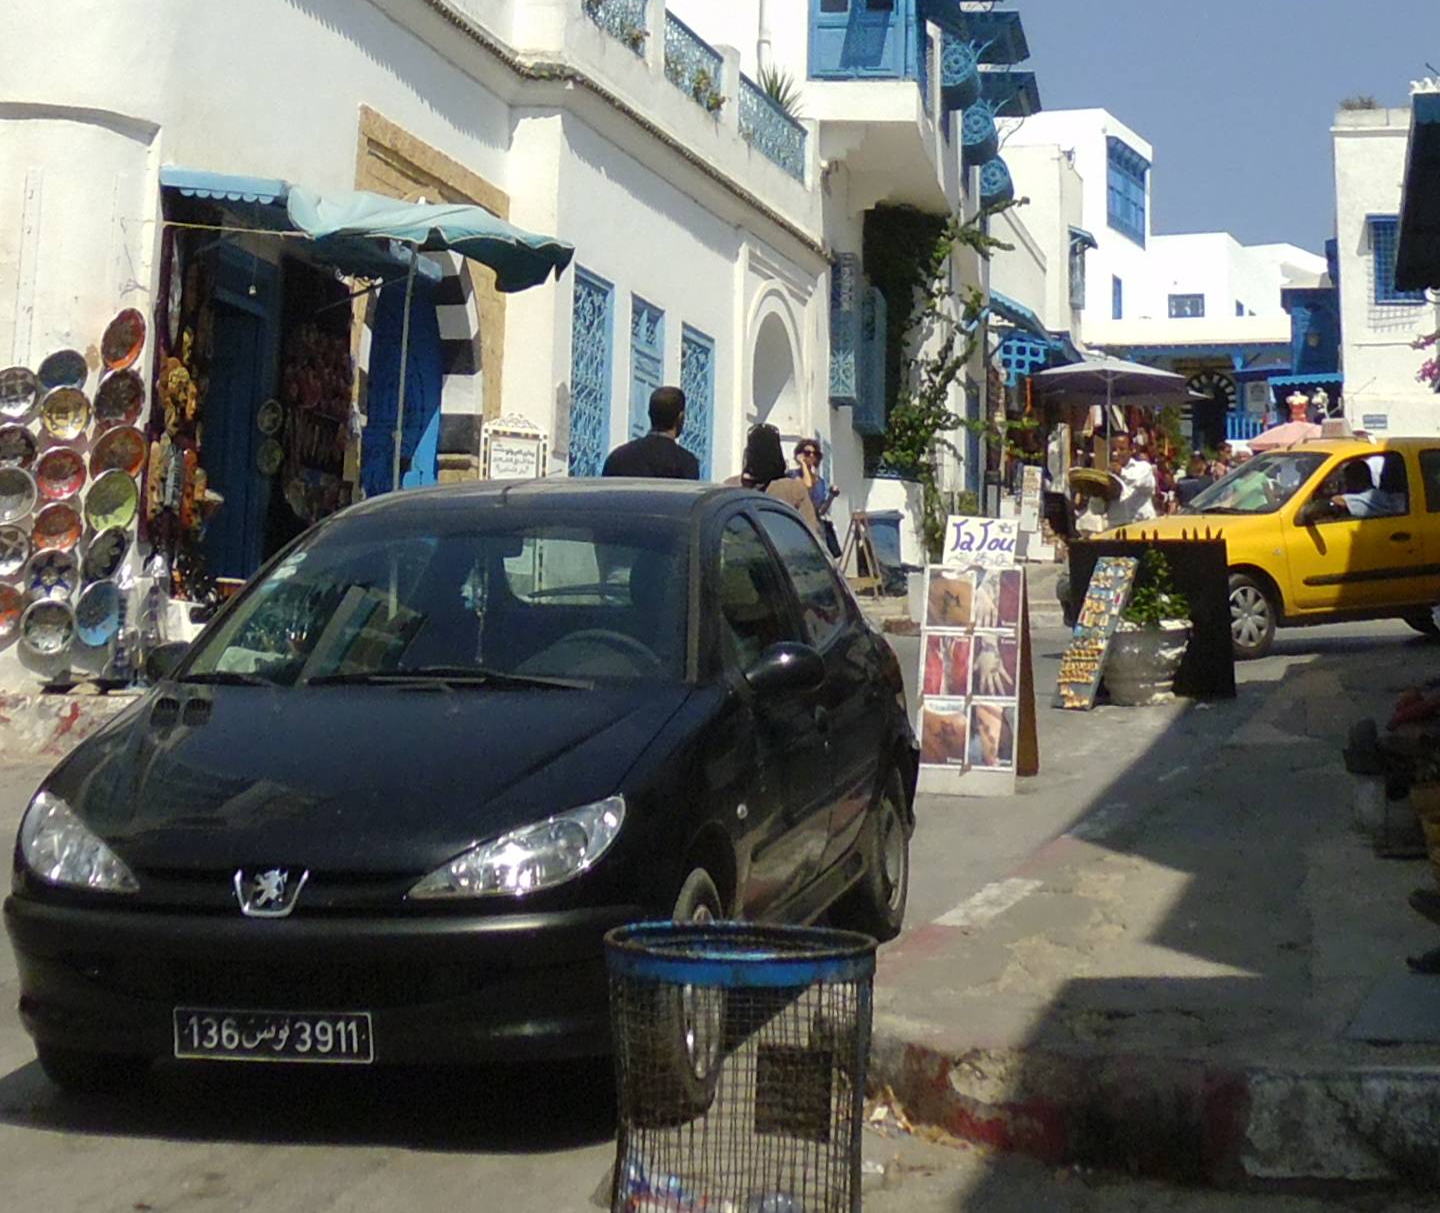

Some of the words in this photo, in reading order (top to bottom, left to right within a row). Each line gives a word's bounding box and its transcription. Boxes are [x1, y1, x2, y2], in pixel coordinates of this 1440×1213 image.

[187, 1015, 239, 1049] 136
[241, 1017, 291, 1051] تونس
[294, 1020, 358, 1053] 3911
